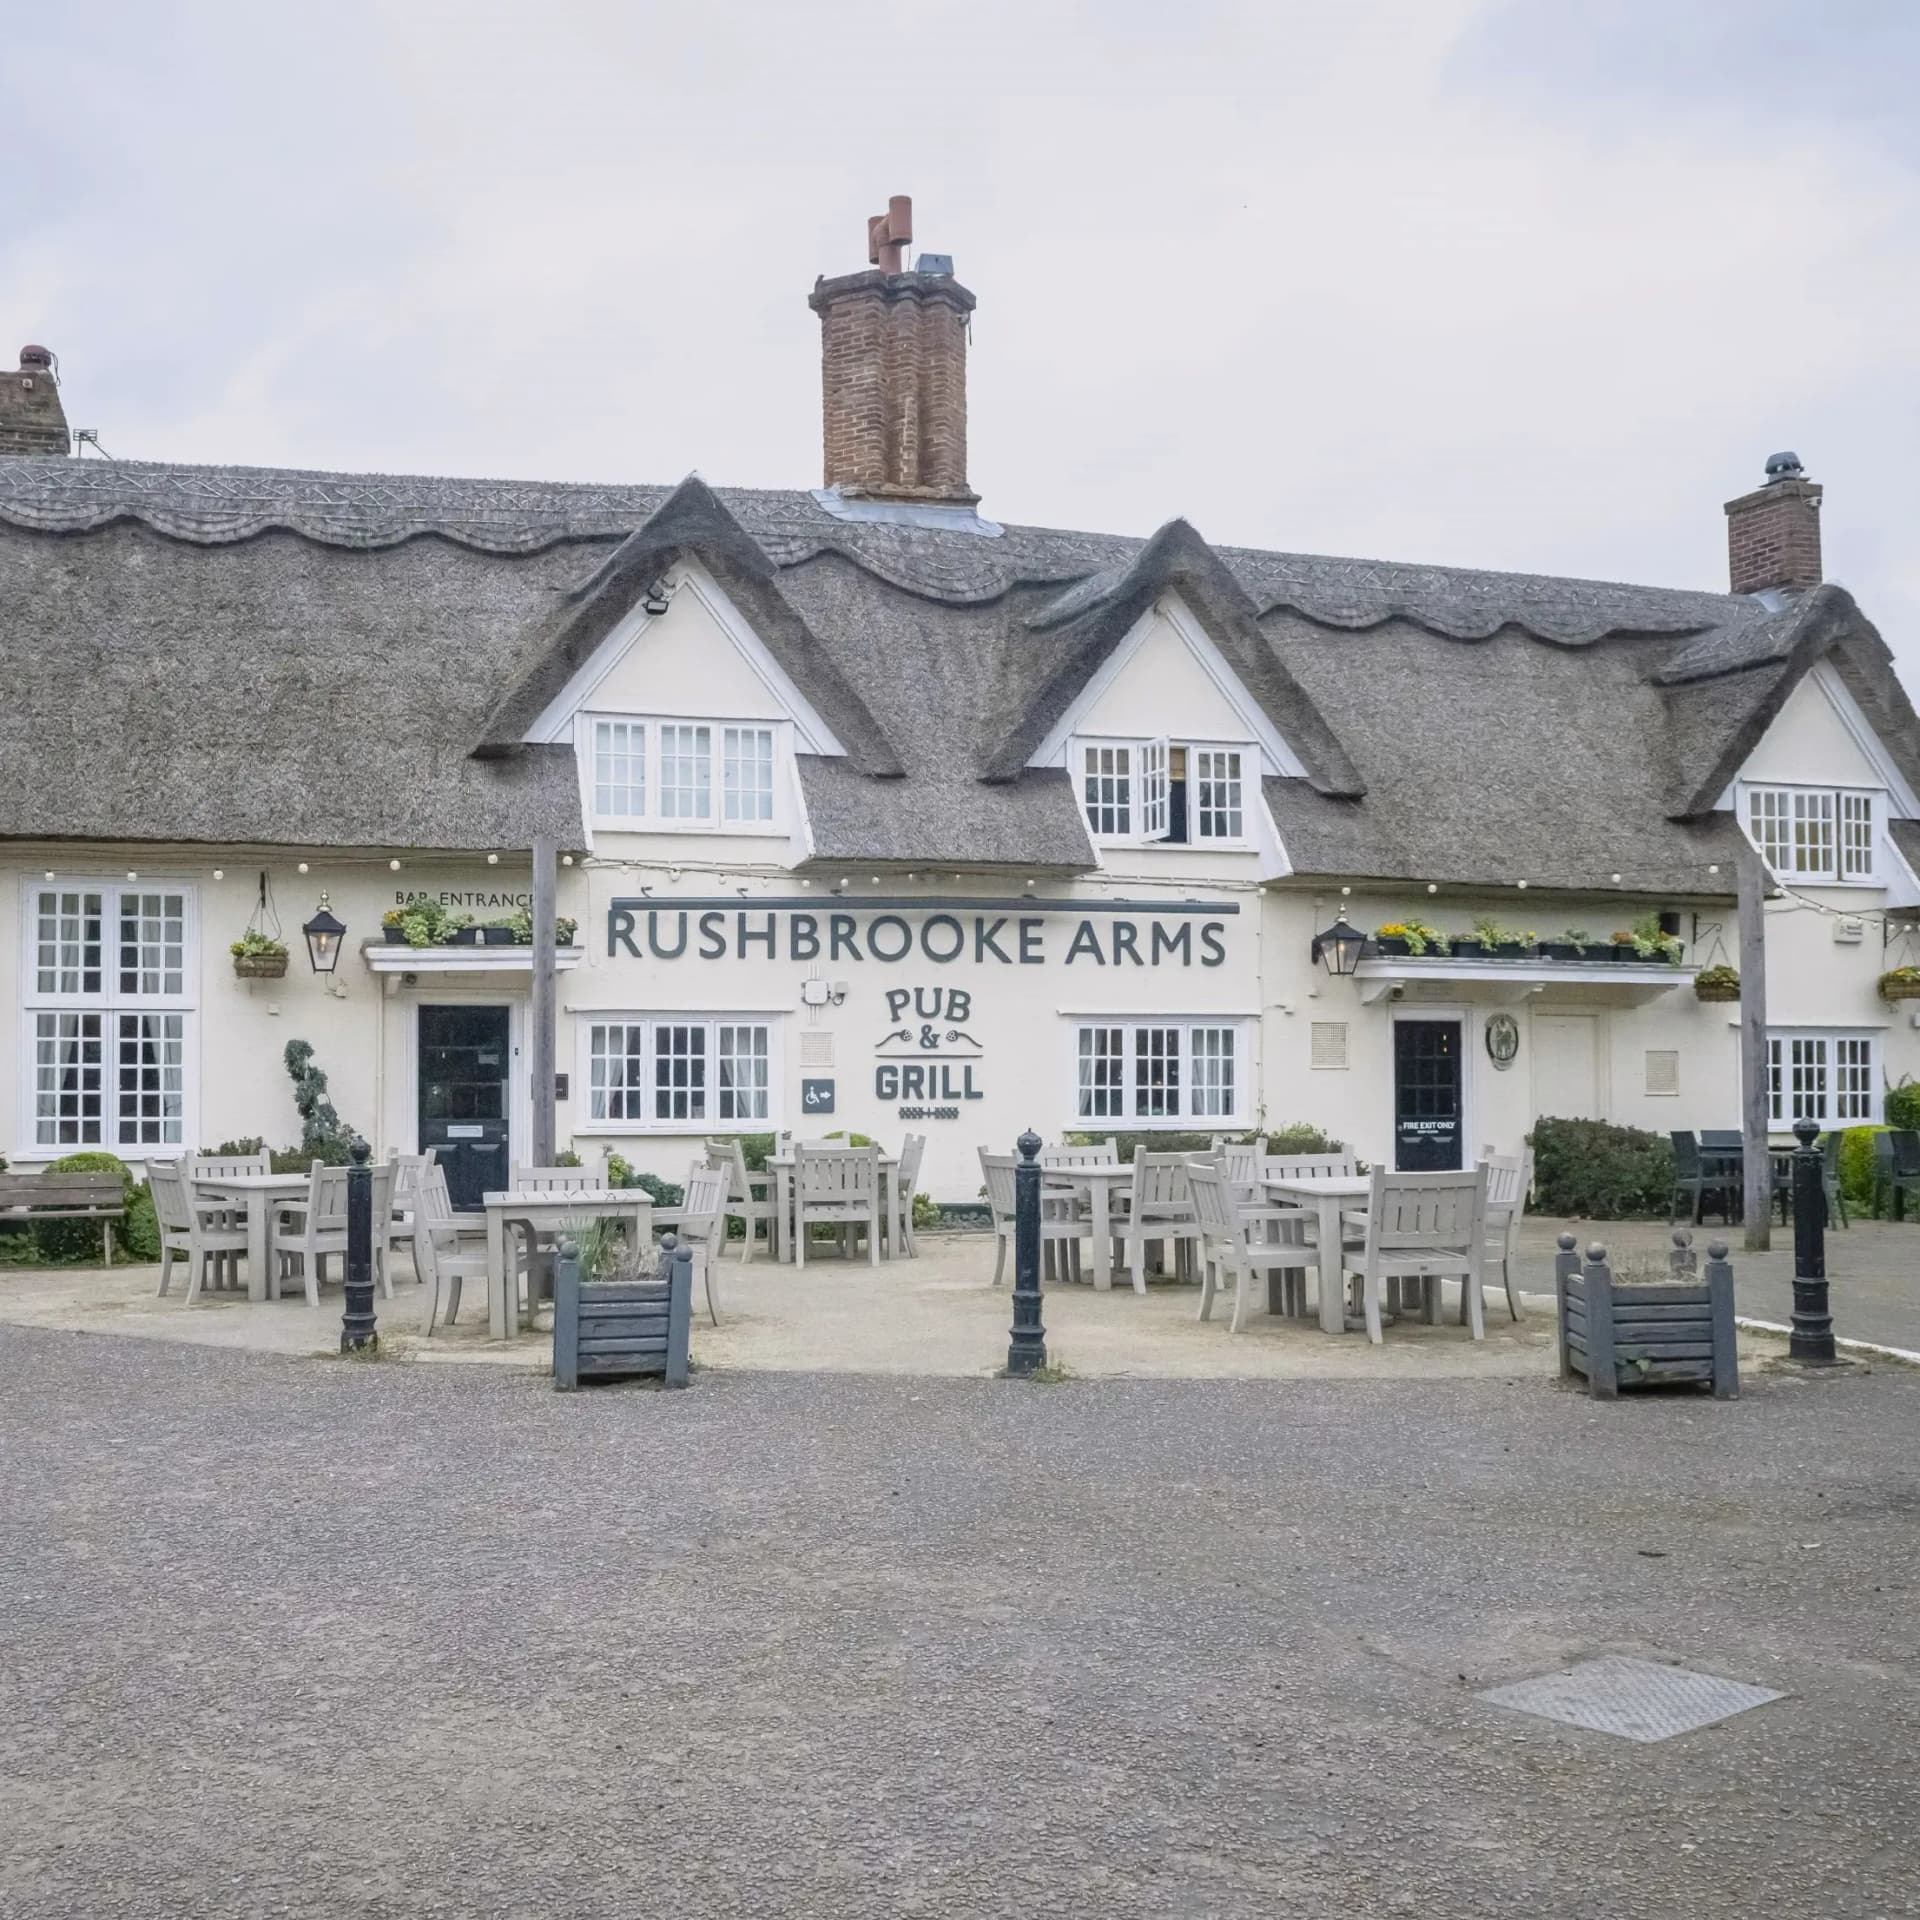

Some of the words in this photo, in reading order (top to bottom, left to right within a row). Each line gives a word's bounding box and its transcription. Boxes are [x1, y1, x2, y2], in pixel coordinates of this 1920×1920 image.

[607, 909, 1045, 964] RUSHBROOKE
[1064, 919, 1226, 967] ARMS
[885, 987, 971, 1022] PUB
[919, 1024, 940, 1049] &
[875, 1064, 984, 1100] GRILL
[1403, 1121, 1419, 1130] FIRE
[1420, 1121, 1437, 1130] EXIT
[1437, 1121, 1456, 1129] ONLY
